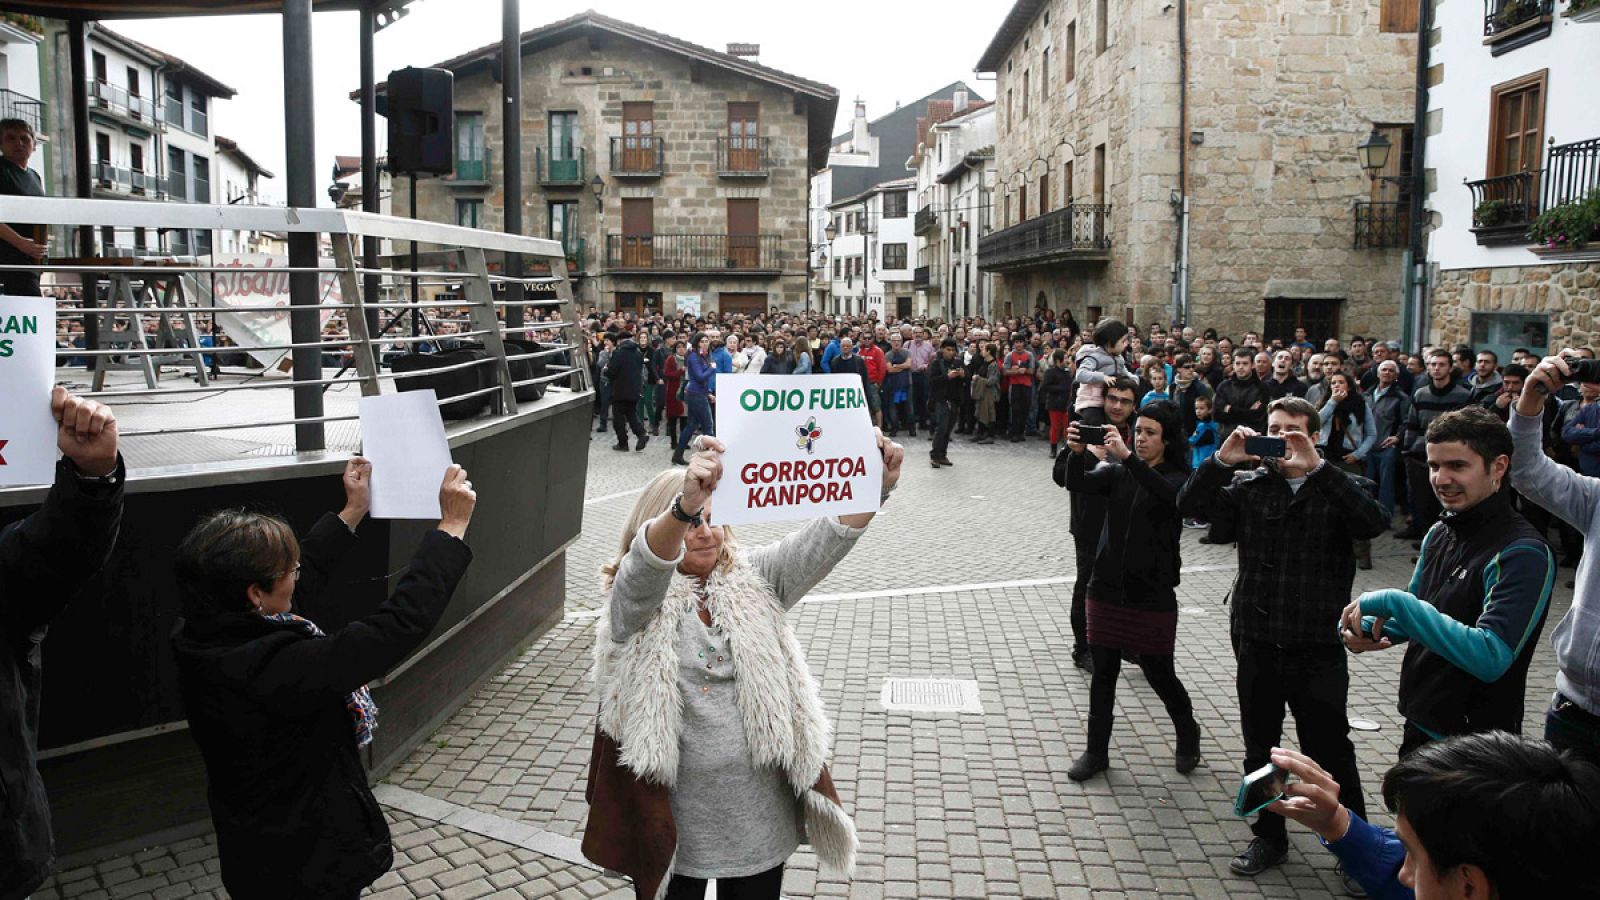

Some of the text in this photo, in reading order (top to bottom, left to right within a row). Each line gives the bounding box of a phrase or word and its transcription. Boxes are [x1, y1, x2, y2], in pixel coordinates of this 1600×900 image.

[523, 283, 557, 292] VEGAS
[0, 315, 37, 334] AN
[739, 388, 867, 412] ODIO FUERA
[740, 456, 867, 485] GORROTOA
[747, 481, 853, 509] KANPORA
